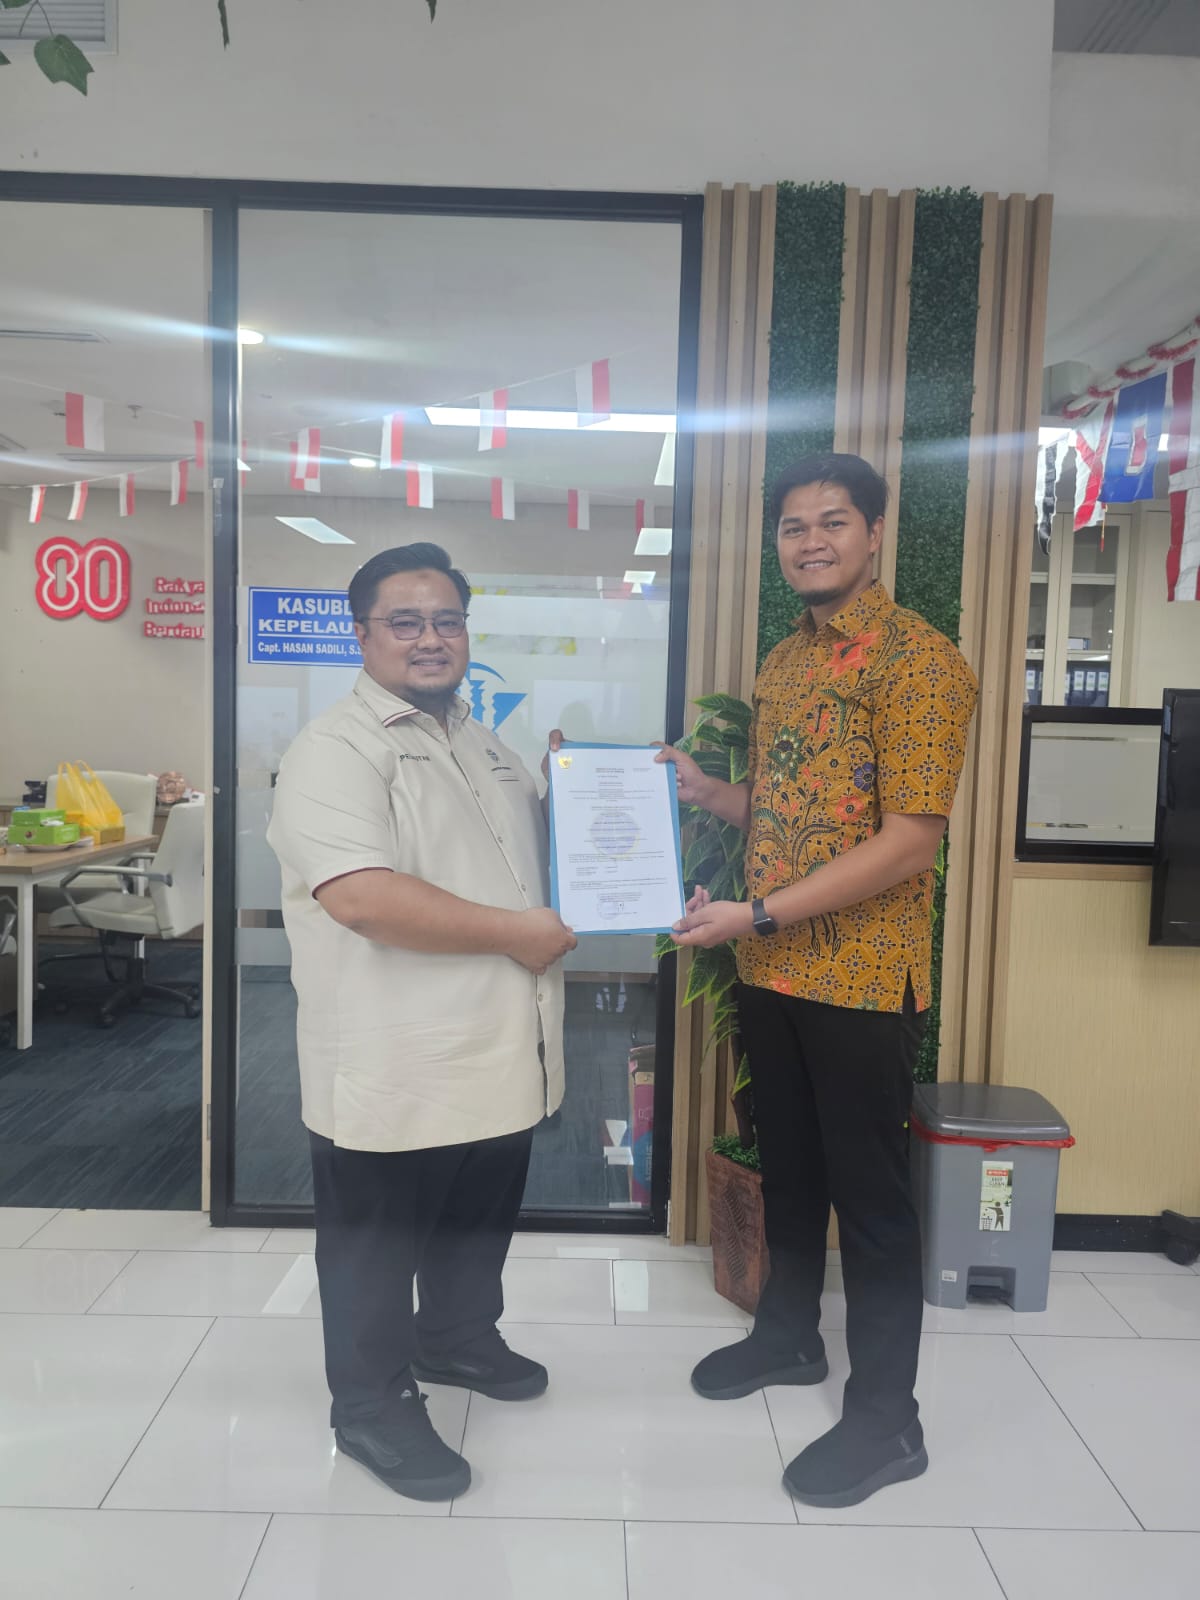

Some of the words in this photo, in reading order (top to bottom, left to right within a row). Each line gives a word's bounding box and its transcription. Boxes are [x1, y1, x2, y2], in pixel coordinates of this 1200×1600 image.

[35, 536, 131, 621] 80
[258, 641, 281, 654] Capt.
[283, 642, 313, 654] HASAN
[315, 644, 347, 657] SADILI,
